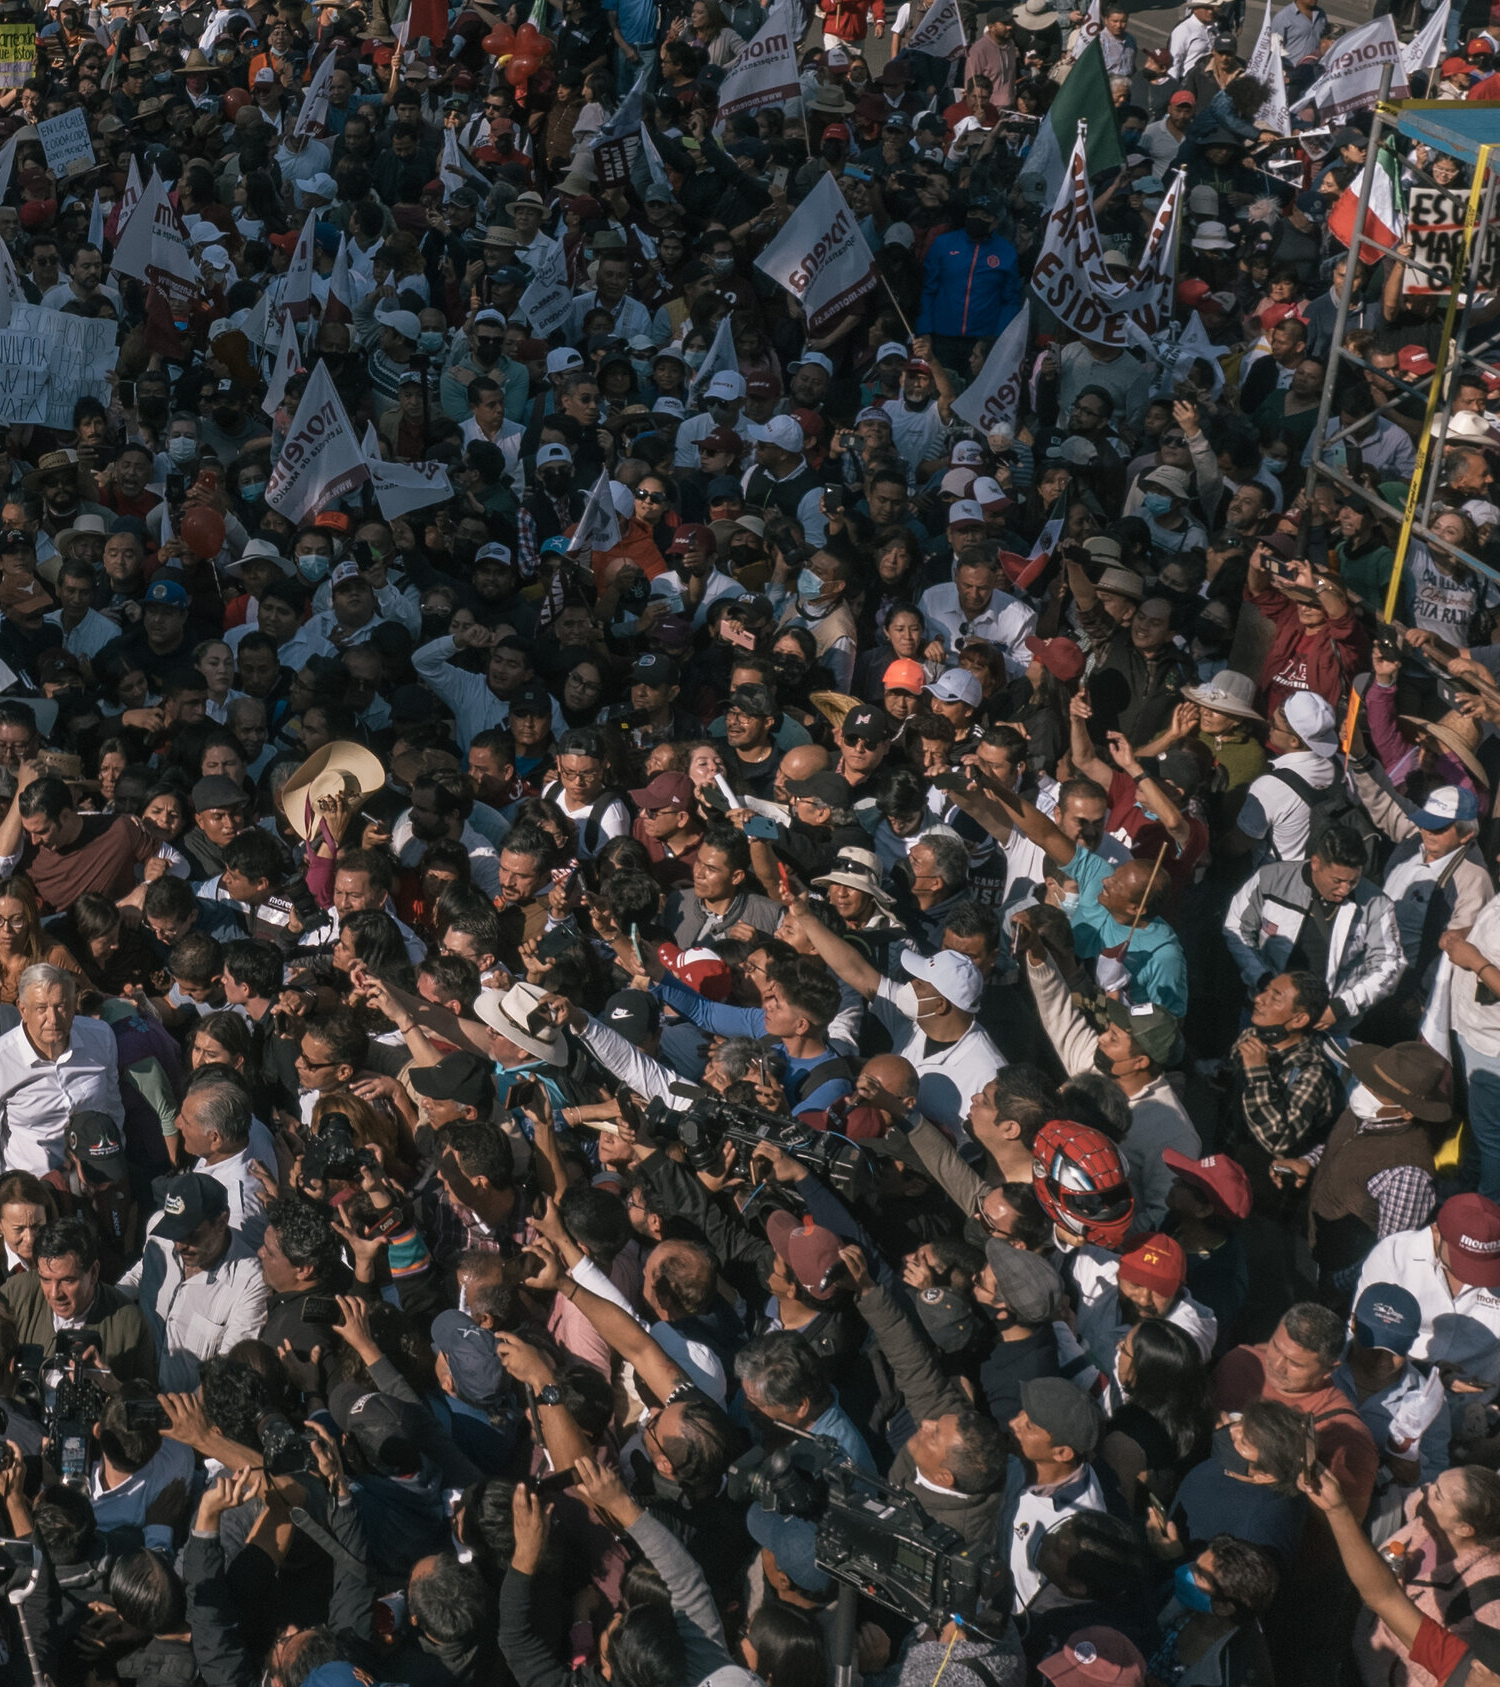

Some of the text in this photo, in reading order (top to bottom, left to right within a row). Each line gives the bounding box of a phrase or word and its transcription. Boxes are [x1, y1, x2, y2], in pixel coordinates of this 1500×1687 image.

[41, 124, 53, 137] EN
[739, 593, 755, 604] CAT
[1143, 1252, 1160, 1266] PT
[1476, 1293, 1500, 1306] more
